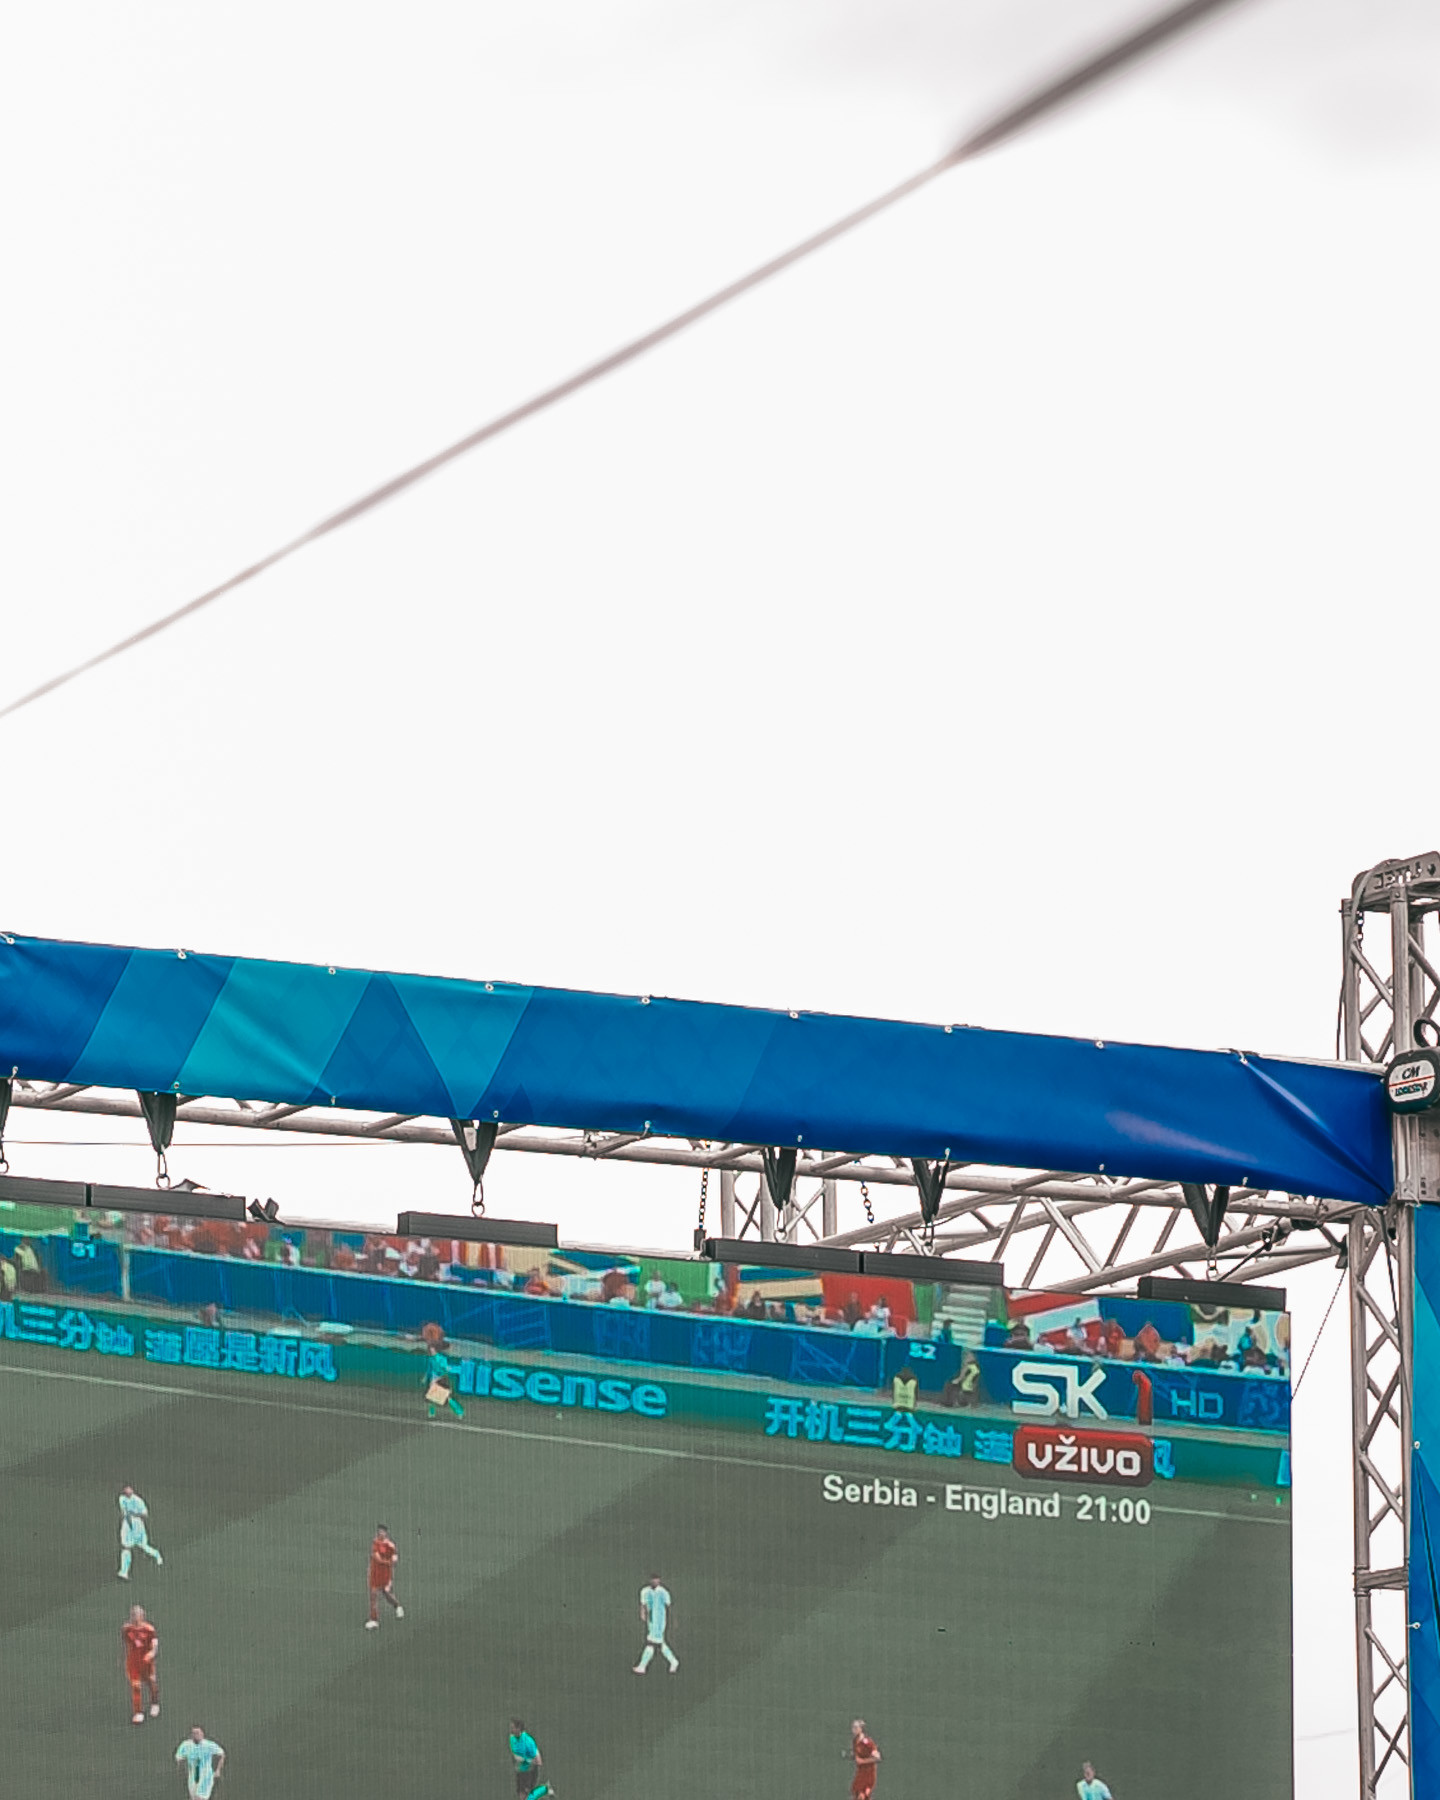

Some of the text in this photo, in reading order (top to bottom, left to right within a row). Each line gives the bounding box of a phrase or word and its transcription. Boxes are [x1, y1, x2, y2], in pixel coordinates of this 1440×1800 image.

[1170, 1387, 1225, 1420] HD
[1027, 1433, 1142, 1477] VŽIVO
[822, 1474, 1152, 1525] Serbia - England 21:00
